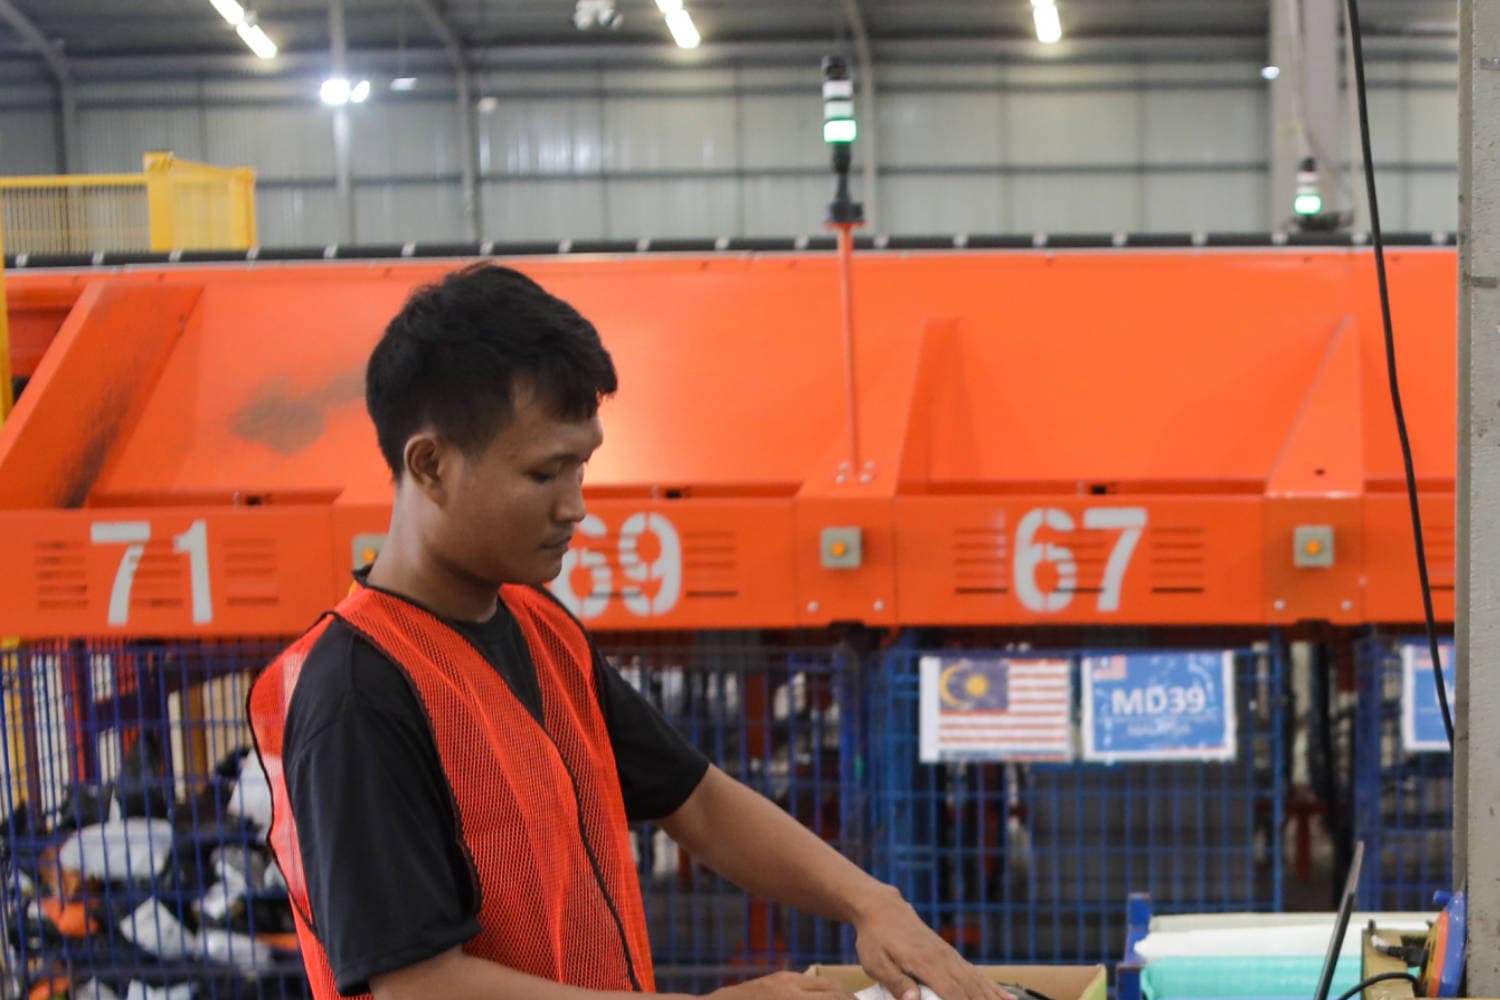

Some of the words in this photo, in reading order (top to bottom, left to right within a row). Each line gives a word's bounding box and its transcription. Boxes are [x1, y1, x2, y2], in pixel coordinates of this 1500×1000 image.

[90, 518, 213, 626] 71
[551, 511, 682, 619] 69
[1014, 506, 1148, 613] 67
[1112, 686, 1206, 715] MD39
